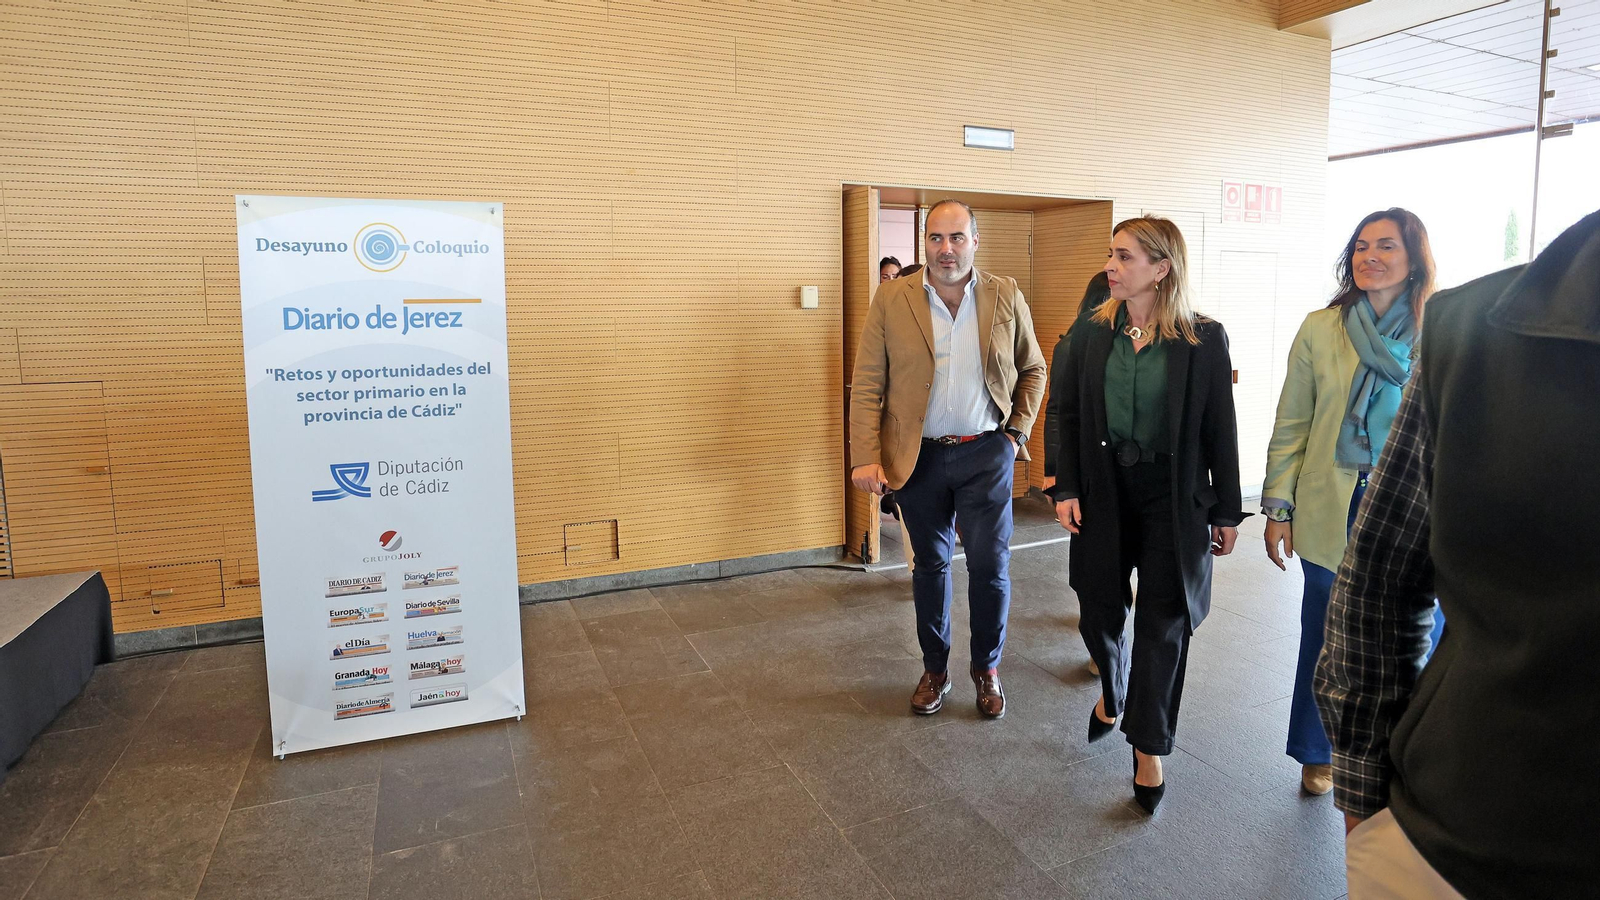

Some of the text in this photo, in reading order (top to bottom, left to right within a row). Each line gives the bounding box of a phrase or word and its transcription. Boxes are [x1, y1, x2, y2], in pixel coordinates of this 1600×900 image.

[256, 238, 489, 257] Desayuno Coloquio
[282, 304, 463, 336] Diario de Jerez
[266, 362, 491, 383] "Retos y oportunidades del
[296, 383, 466, 402] sector primario en la
[304, 403, 462, 426] provincia de Cádiz"
[378, 457, 464, 477] Diputación
[379, 479, 449, 497] de Cádiz
[404, 573, 424, 581] Diario
[436, 570, 454, 579] Jerez
[328, 578, 352, 588] DIARIO
[405, 598, 460, 610] Diario de Sevilla
[408, 630, 437, 640] Huelva
[345, 637, 370, 648] el Día
[410, 658, 461, 671] Málaga hoy
[335, 666, 388, 680] Granada Hoy
[418, 689, 461, 702] Jaén hoy
[336, 697, 390, 710] Diario de Almería
